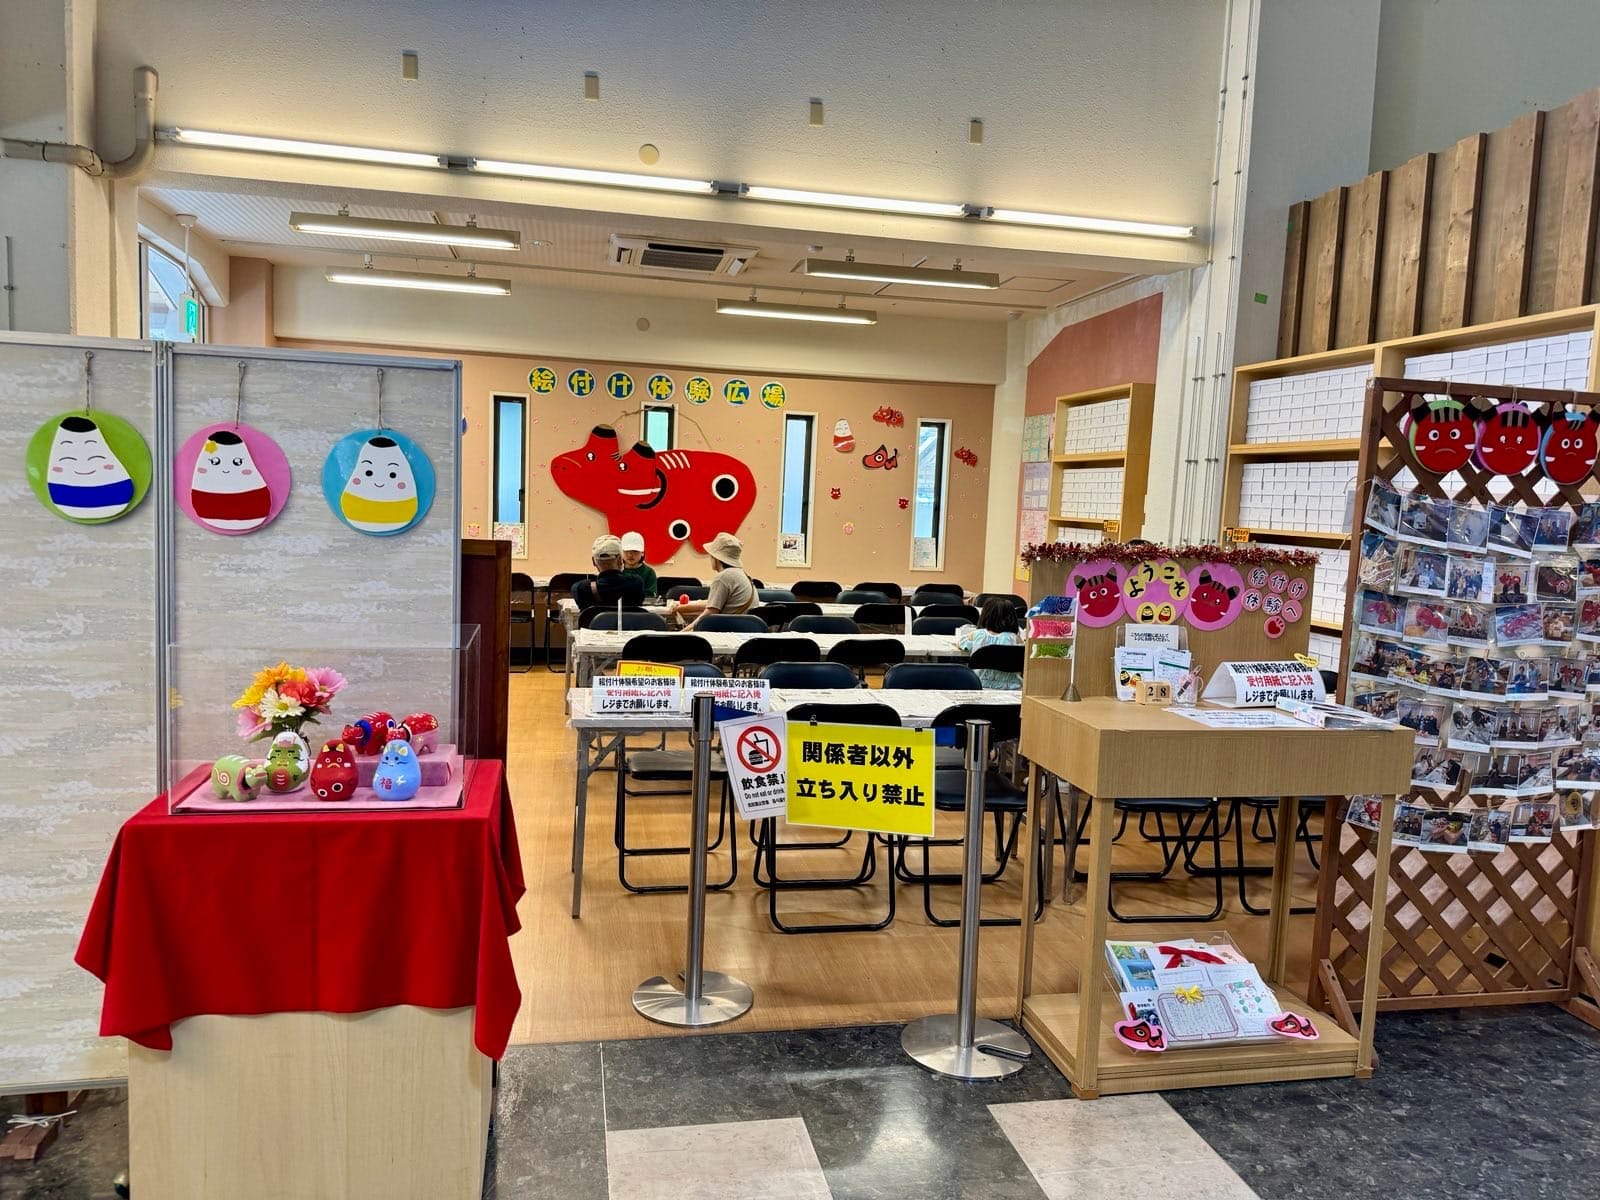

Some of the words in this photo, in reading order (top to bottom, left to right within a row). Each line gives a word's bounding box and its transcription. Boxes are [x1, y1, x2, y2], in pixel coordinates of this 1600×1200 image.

[530, 370, 784, 408] 絵付け体験広場
[1129, 564, 1187, 598] ようこそ
[1251, 568, 1304, 596] 絵付け
[1245, 592, 1297, 615] 体験へ
[599, 677, 676, 687] 絵付け体験希望のお客様は
[690, 679, 766, 688] 絵付け体験希望のお客様は
[1247, 675, 1315, 687] 受付用紙に記入後
[602, 698, 672, 710] レジまでお願いします。
[1245, 688, 1317, 703] レジまでお願いします。
[802, 741, 915, 769] 関係者以外
[797, 778, 925, 806] 立ち入り禁止
